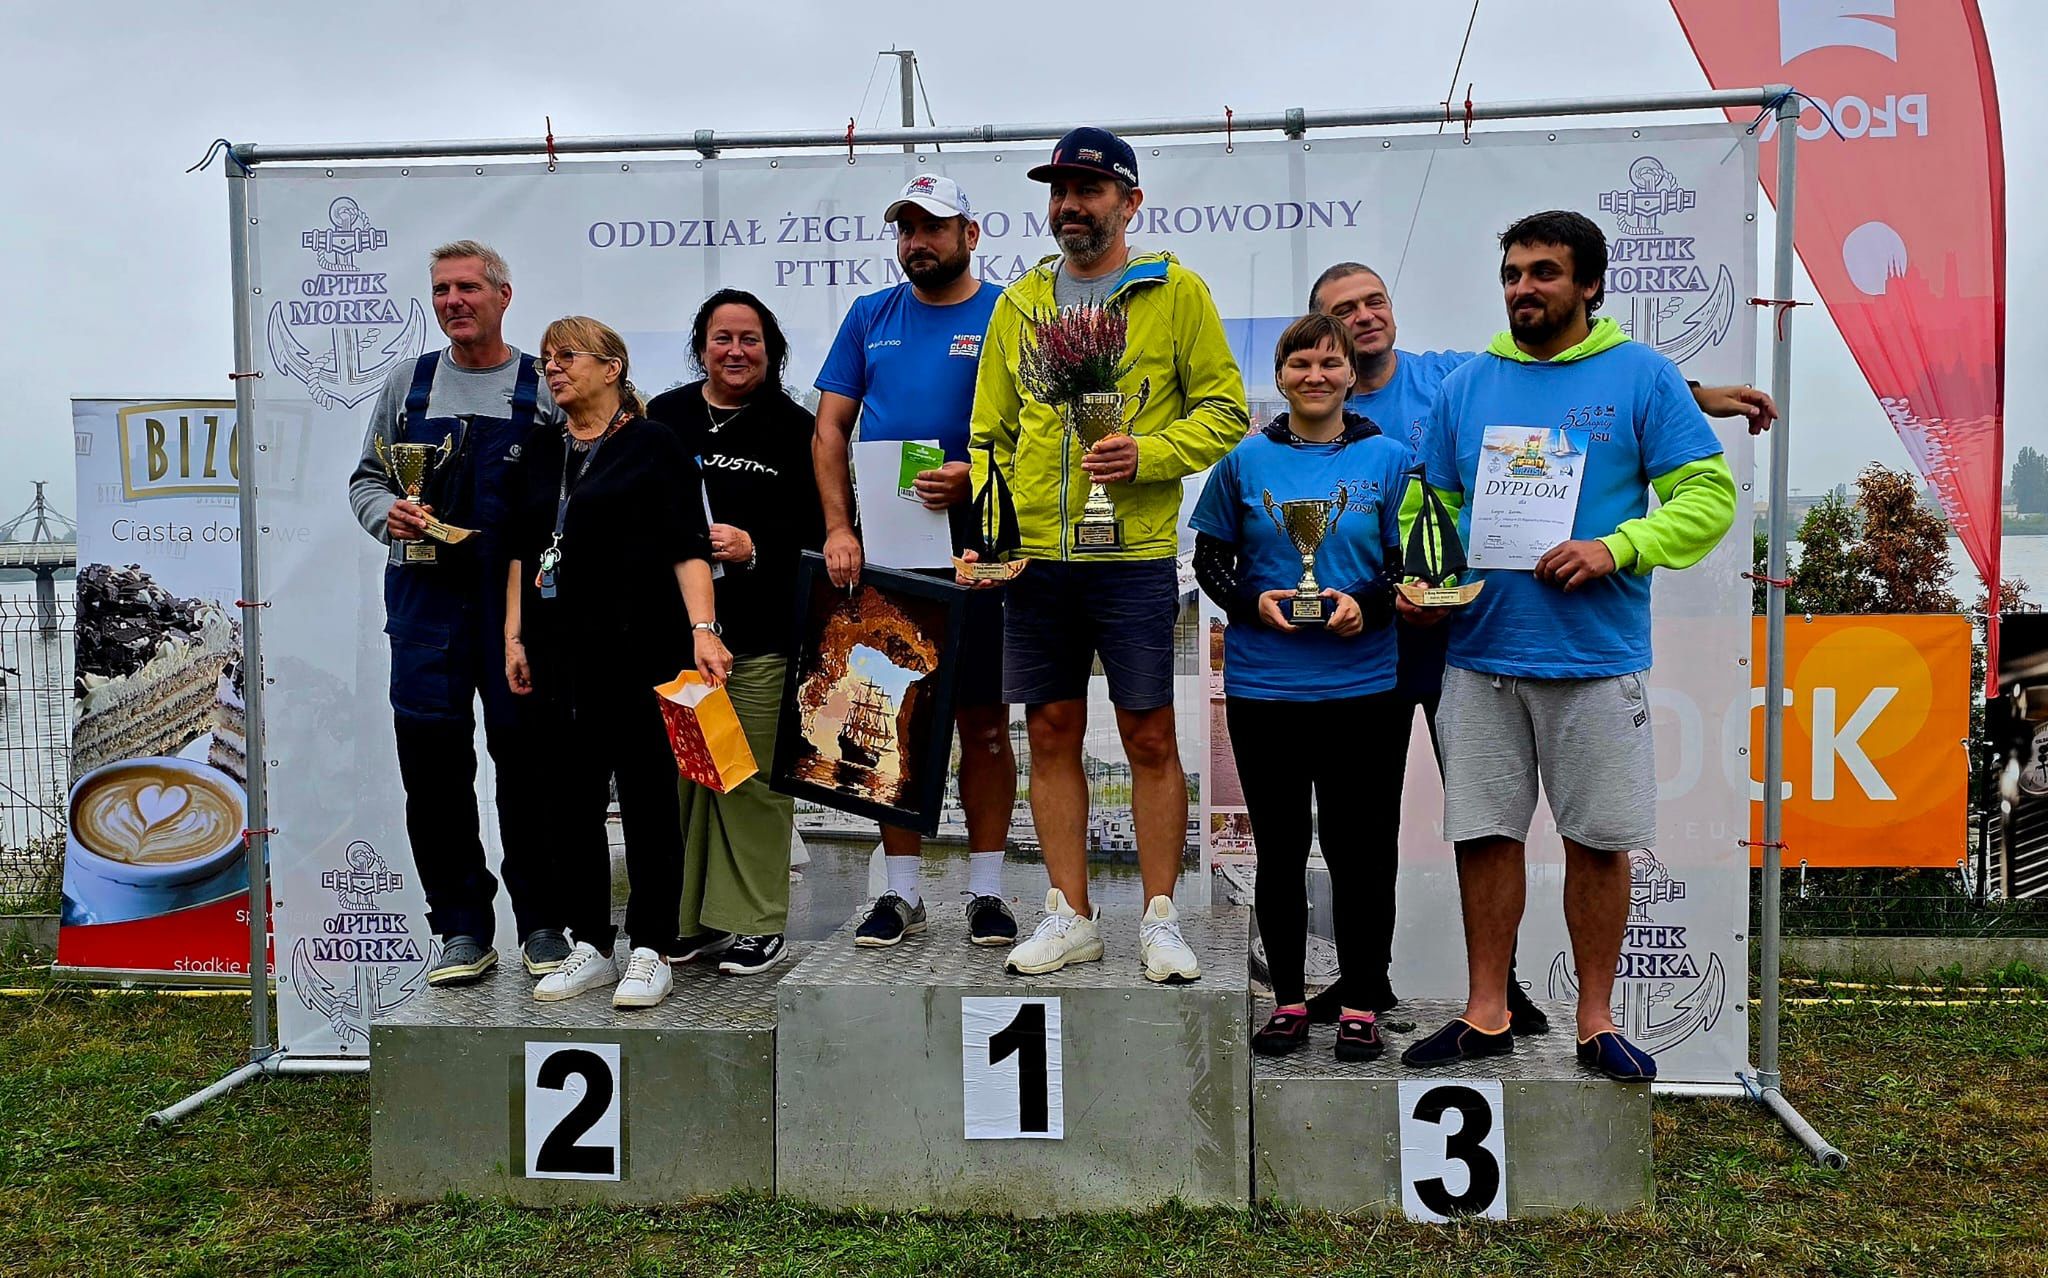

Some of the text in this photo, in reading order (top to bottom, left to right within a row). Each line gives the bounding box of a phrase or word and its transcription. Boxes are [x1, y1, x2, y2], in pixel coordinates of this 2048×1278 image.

[588, 199, 1363, 249] ODDZIAŁ ŻEGLAO MOROWODNY
[774, 253, 1029, 288] PTTK MKA
[290, 299, 404, 325] MORKA
[950, 343, 980, 352] CLASS
[952, 334, 983, 342] MICRO
[1485, 480, 1569, 500] DYPLOM
[112, 519, 194, 543] Ciasta
[312, 937, 423, 962] MORKA
[174, 956, 241, 975] słodkie
[1614, 953, 1701, 979] ORKA
[988, 1003, 1049, 1133] 1
[536, 1048, 615, 1175] 2
[1412, 1084, 1500, 1218] 3
